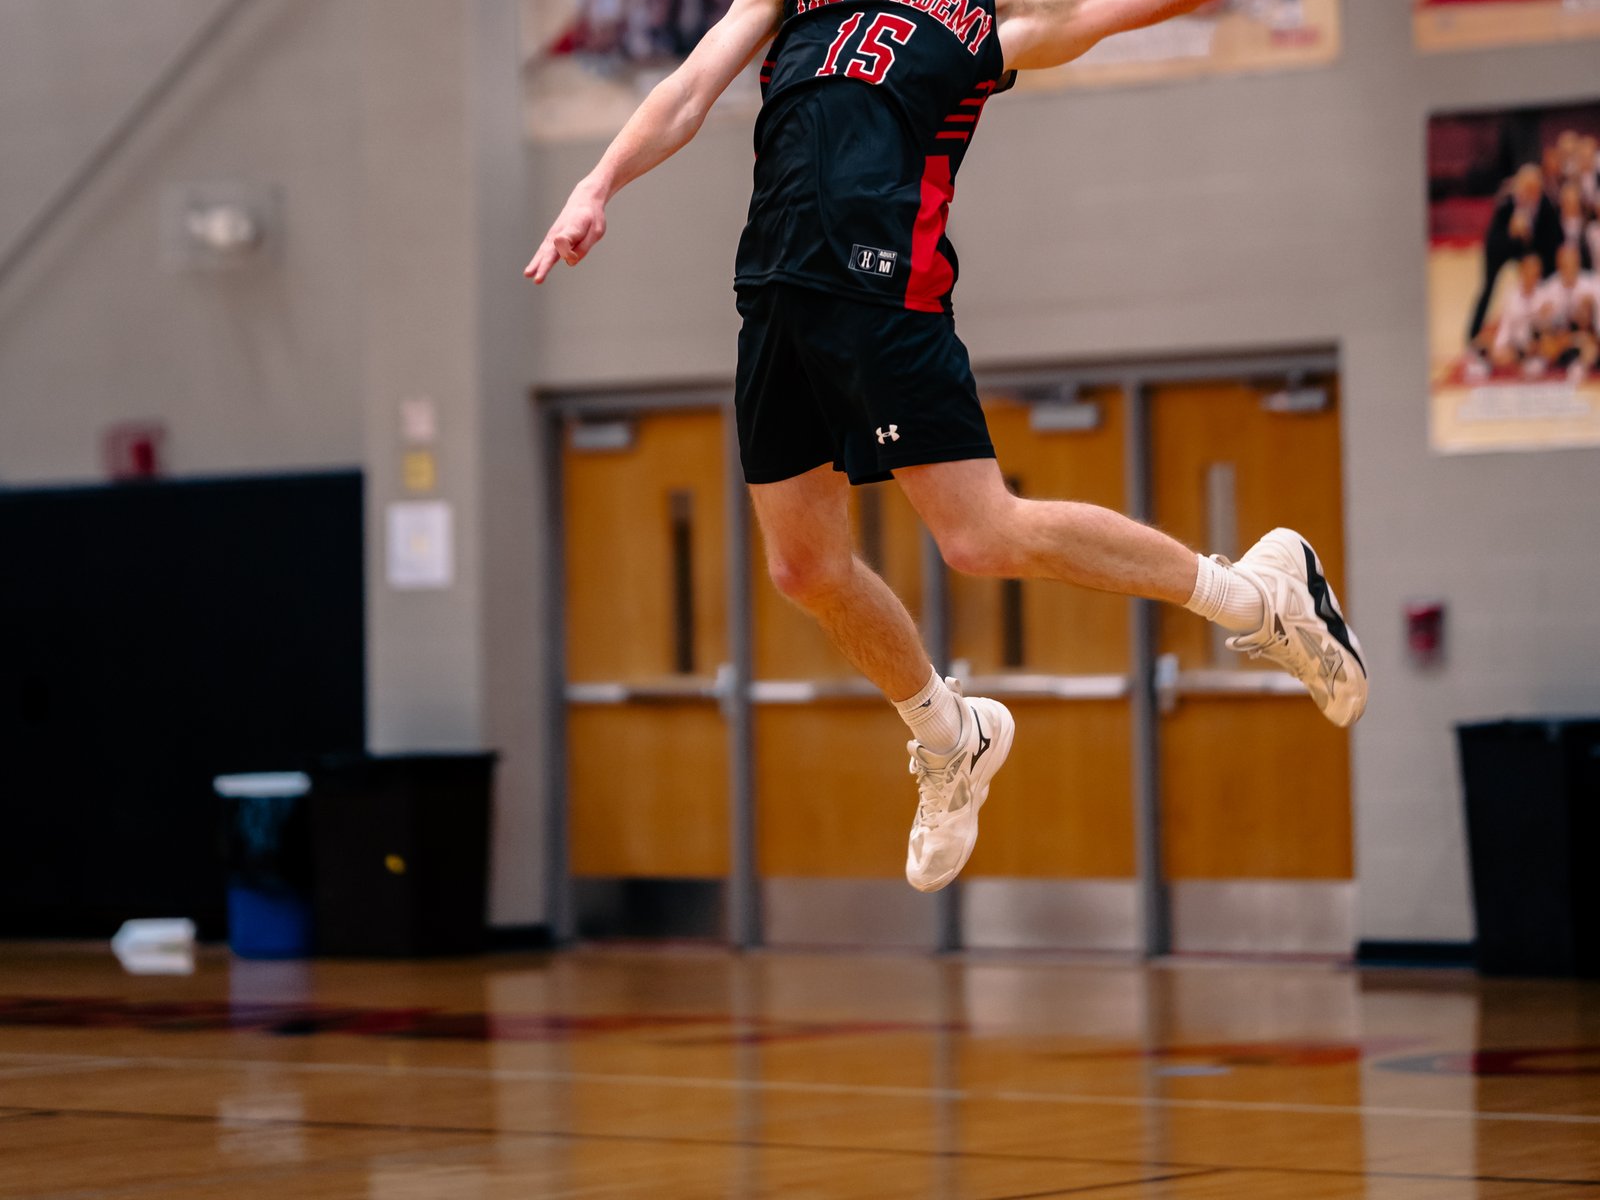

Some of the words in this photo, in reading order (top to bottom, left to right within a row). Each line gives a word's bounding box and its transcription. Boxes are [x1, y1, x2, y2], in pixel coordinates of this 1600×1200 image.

[815, 12, 917, 85] 15
[879, 251, 896, 259] ADULT
[878, 260, 892, 273] M
